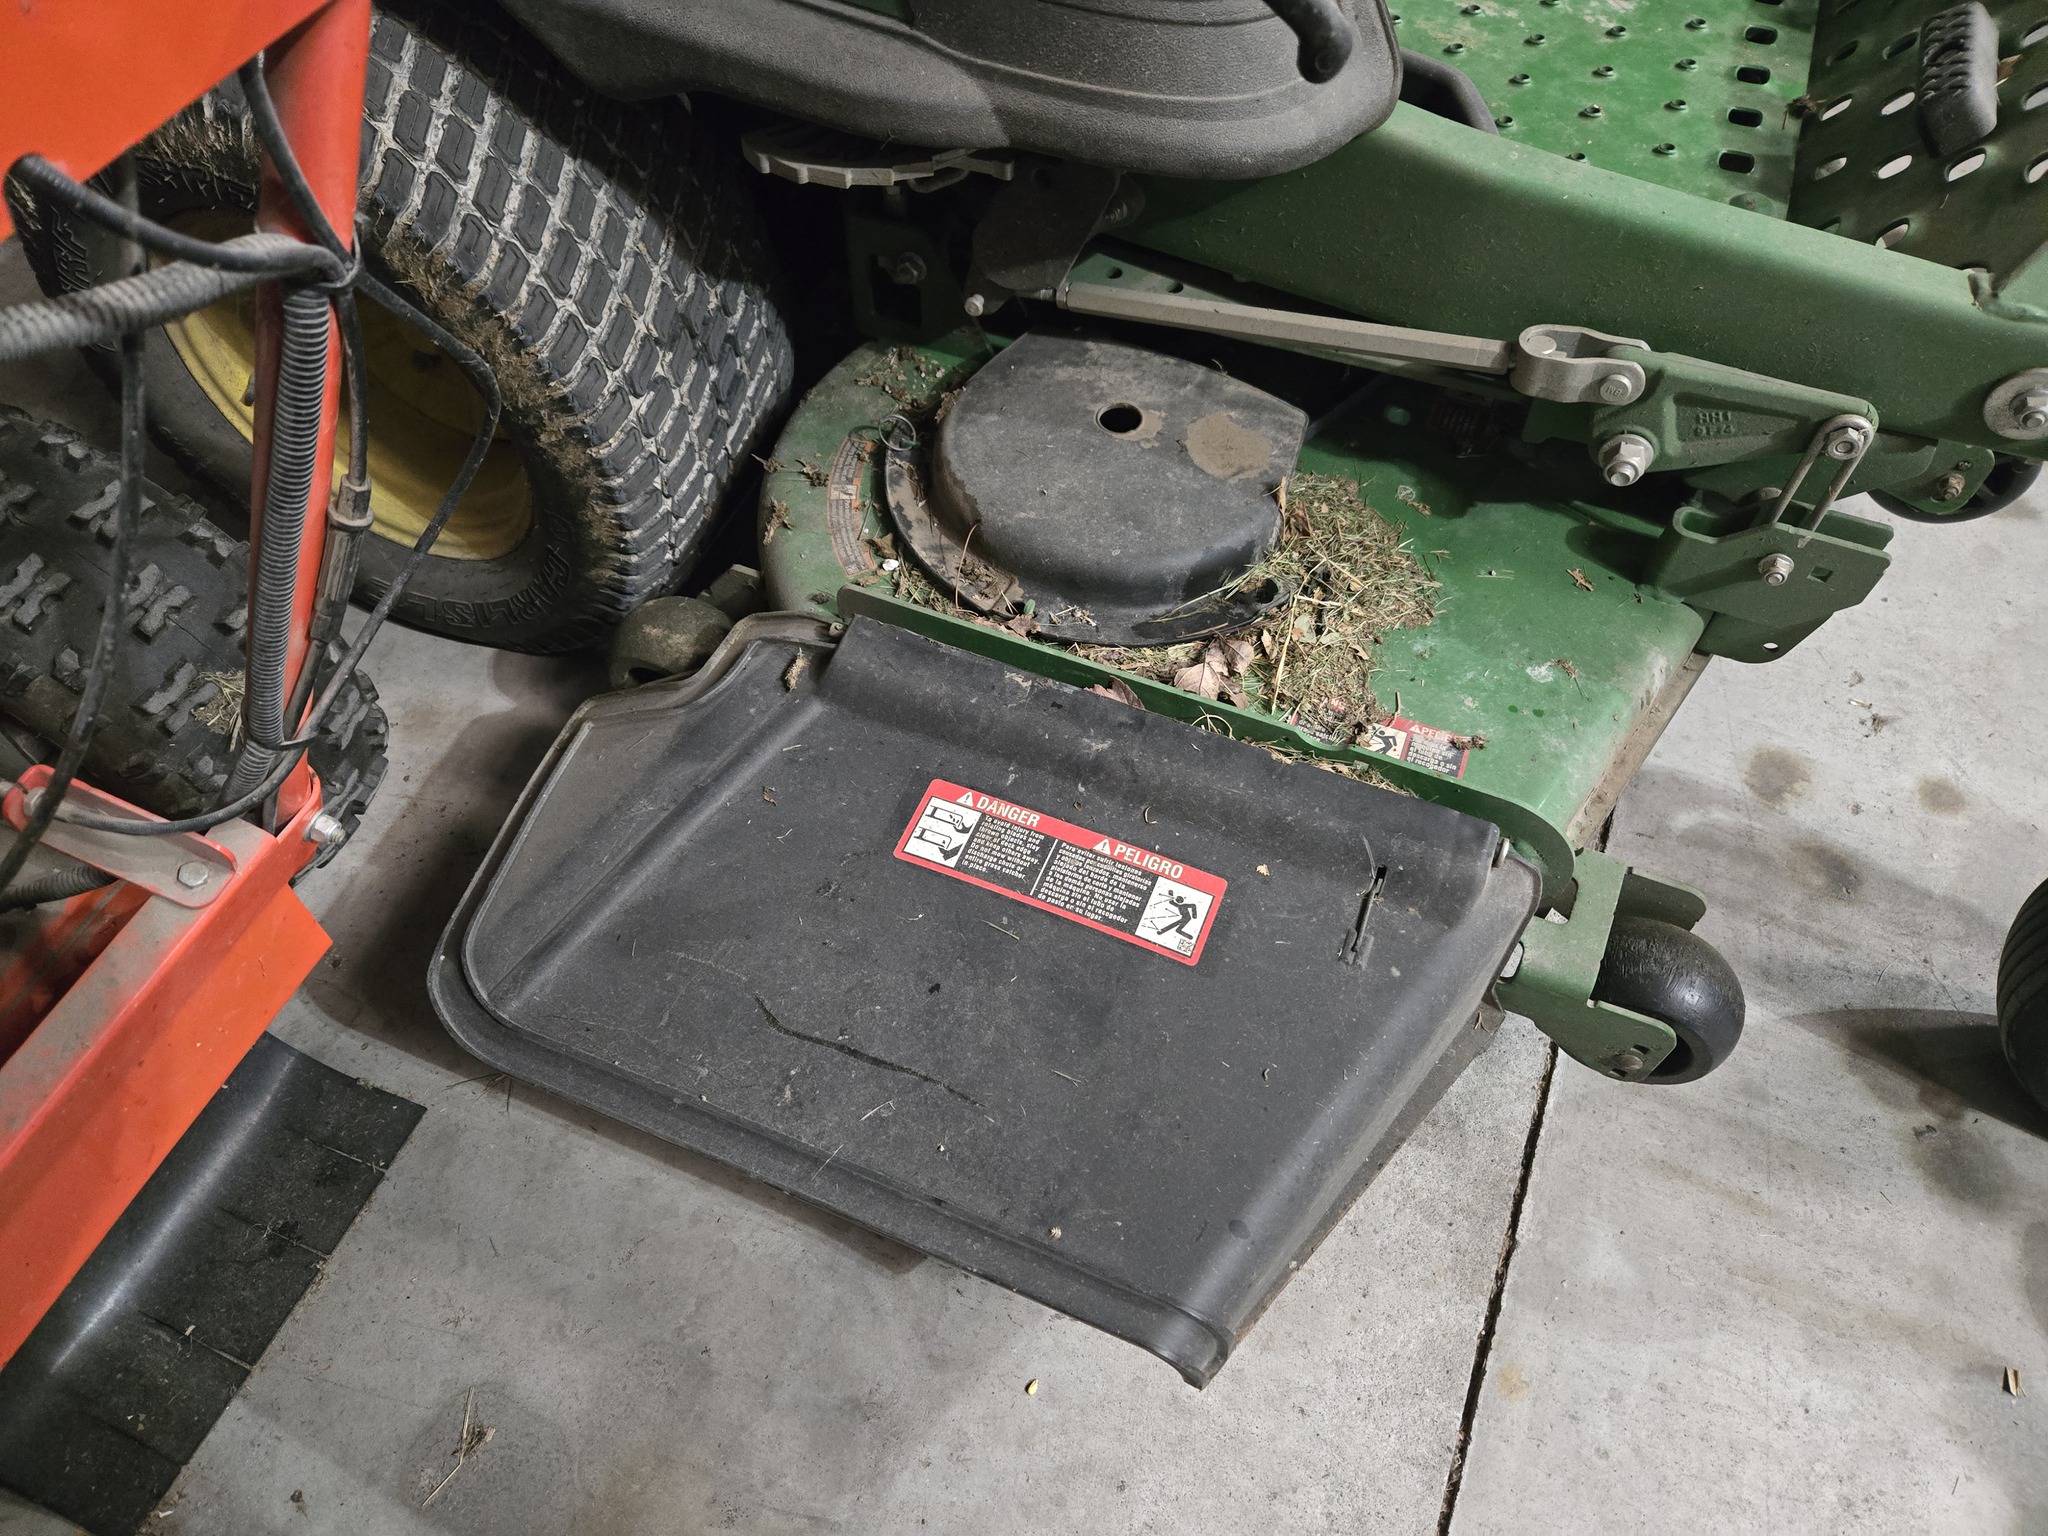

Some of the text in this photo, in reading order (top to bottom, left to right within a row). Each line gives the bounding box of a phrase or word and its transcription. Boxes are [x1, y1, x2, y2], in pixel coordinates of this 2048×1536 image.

[976, 796, 1040, 828] DANGER
[978, 826, 999, 837] thrown
[1026, 843, 1039, 851] stay
[981, 820, 1039, 845] rotating blades and
[993, 818, 1010, 827] avoid
[1011, 824, 1029, 834] injury
[1029, 831, 1044, 840] from
[972, 837, 1040, 865] and keep others away.
[975, 831, 992, 841] clear
[1000, 840, 1015, 849] deck
[1015, 845, 1031, 855] edge
[964, 854, 1025, 879] entire grass catcher
[967, 848, 997, 862] discharge
[998, 859, 1015, 869] chute
[991, 850, 1005, 858] mow
[1006, 855, 1030, 866] without
[1113, 843, 1183, 879] PELIGRO
